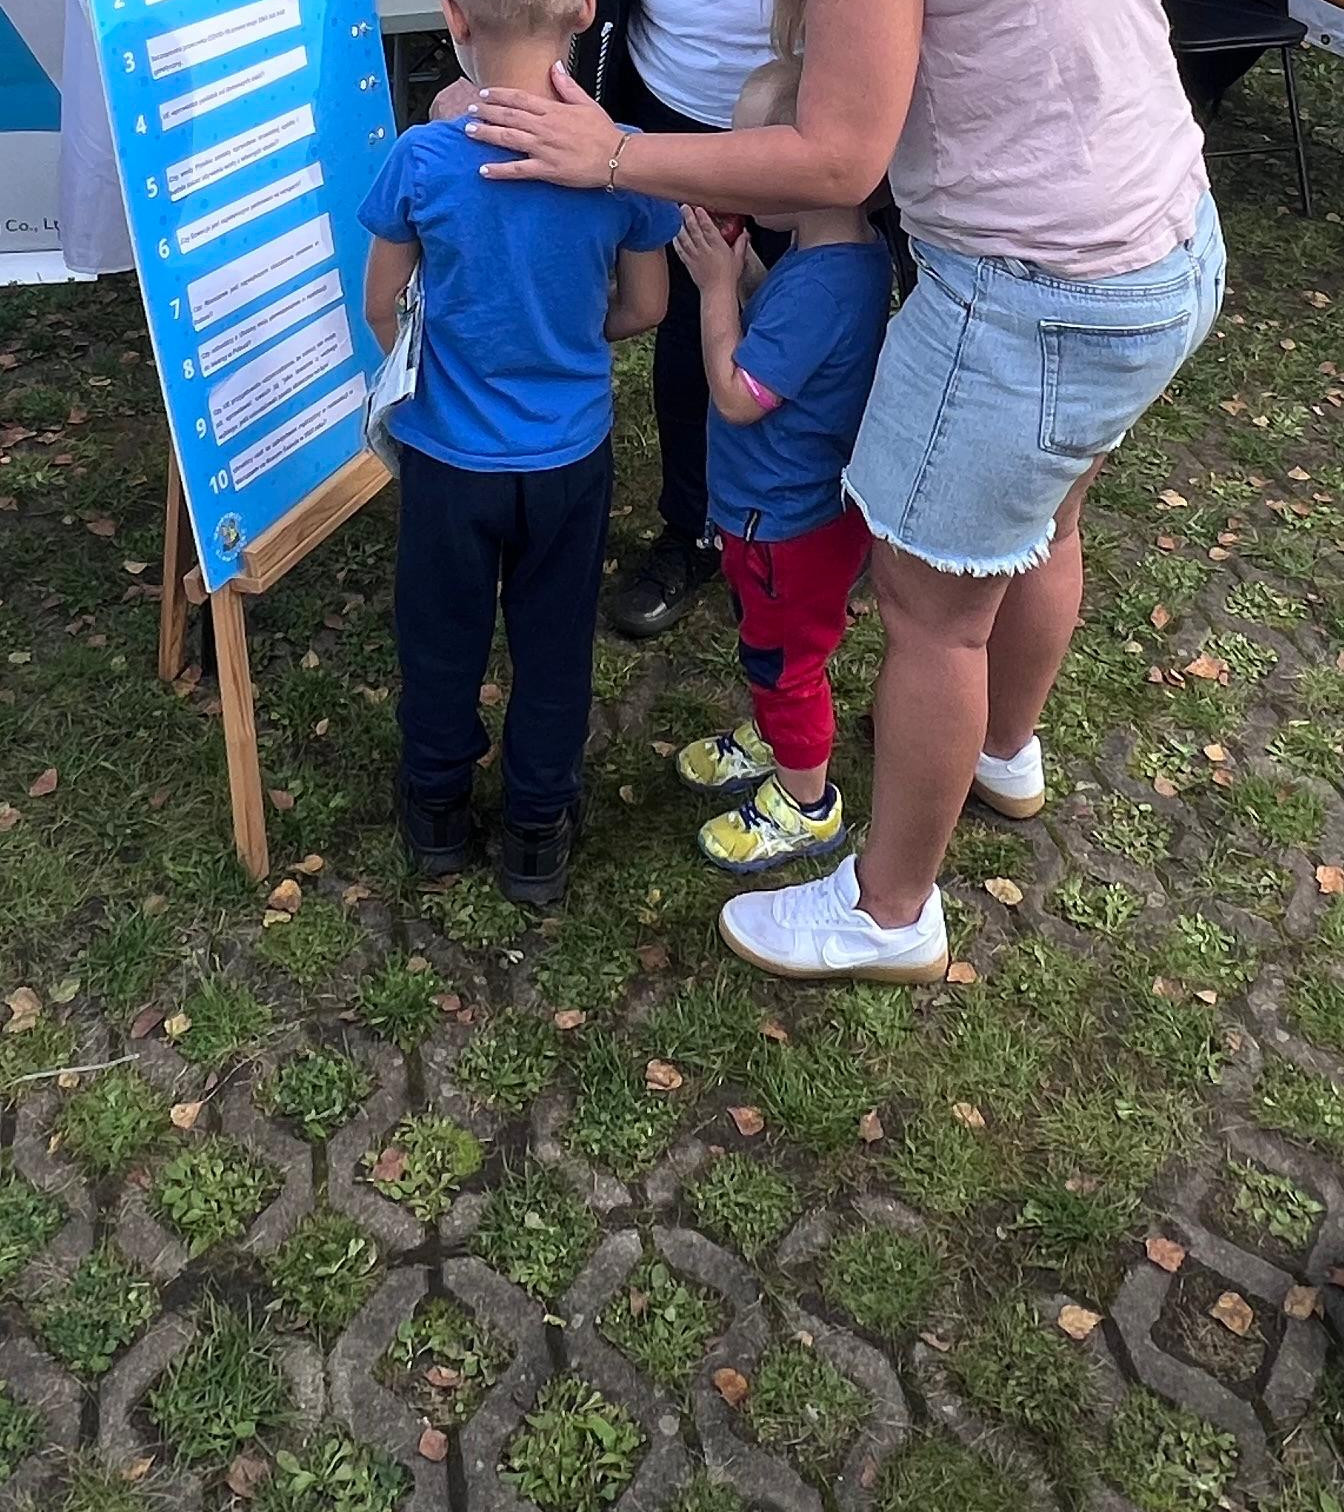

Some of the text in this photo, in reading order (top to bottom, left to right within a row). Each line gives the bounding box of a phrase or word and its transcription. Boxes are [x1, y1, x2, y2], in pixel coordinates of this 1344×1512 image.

[123, 51, 136, 73] 3
[135, 115, 147, 134] 4
[146, 176, 158, 198] 5
[6, 219, 38, 234] Co.,
[43, 218, 60, 232] Lt
[158, 238, 170, 259] 6
[169, 298, 180, 320] 7
[182, 358, 194, 379] 8
[195, 418, 207, 439] 9
[209, 469, 229, 494] 10
